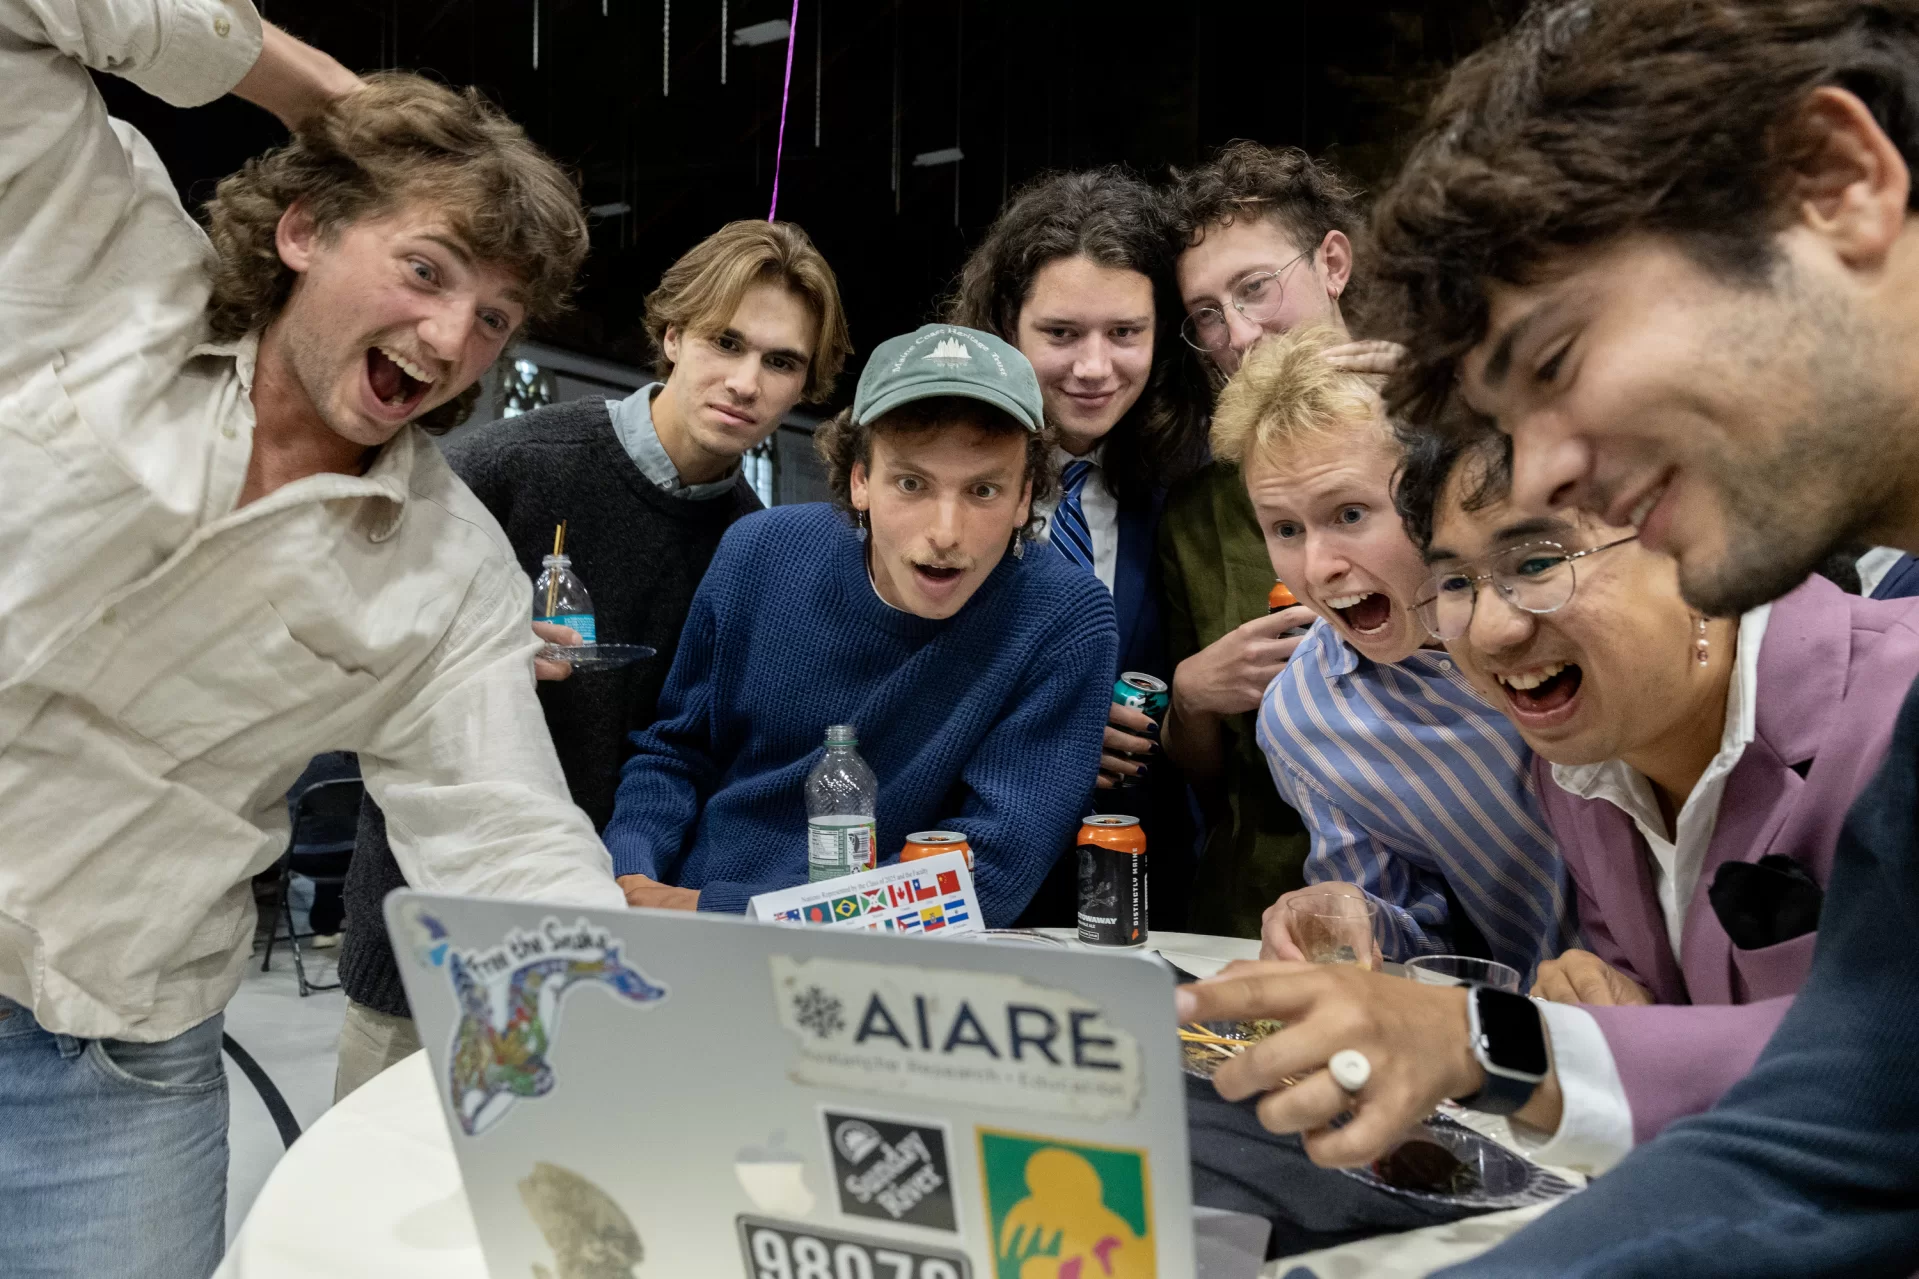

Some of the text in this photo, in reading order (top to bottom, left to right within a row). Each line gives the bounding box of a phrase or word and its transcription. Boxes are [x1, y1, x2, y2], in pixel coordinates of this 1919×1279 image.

[892, 327, 1008, 377] Maine Coast Heritage Trust
[821, 885, 851, 899] Represented
[865, 879, 880, 888] Class
[884, 874, 897, 883] 2025
[912, 867, 929, 877] Faculty
[510, 933, 544, 960] the
[855, 989, 1123, 1072] AIARE
[845, 1130, 932, 1204] Sunday
[875, 1163, 943, 1219] River
